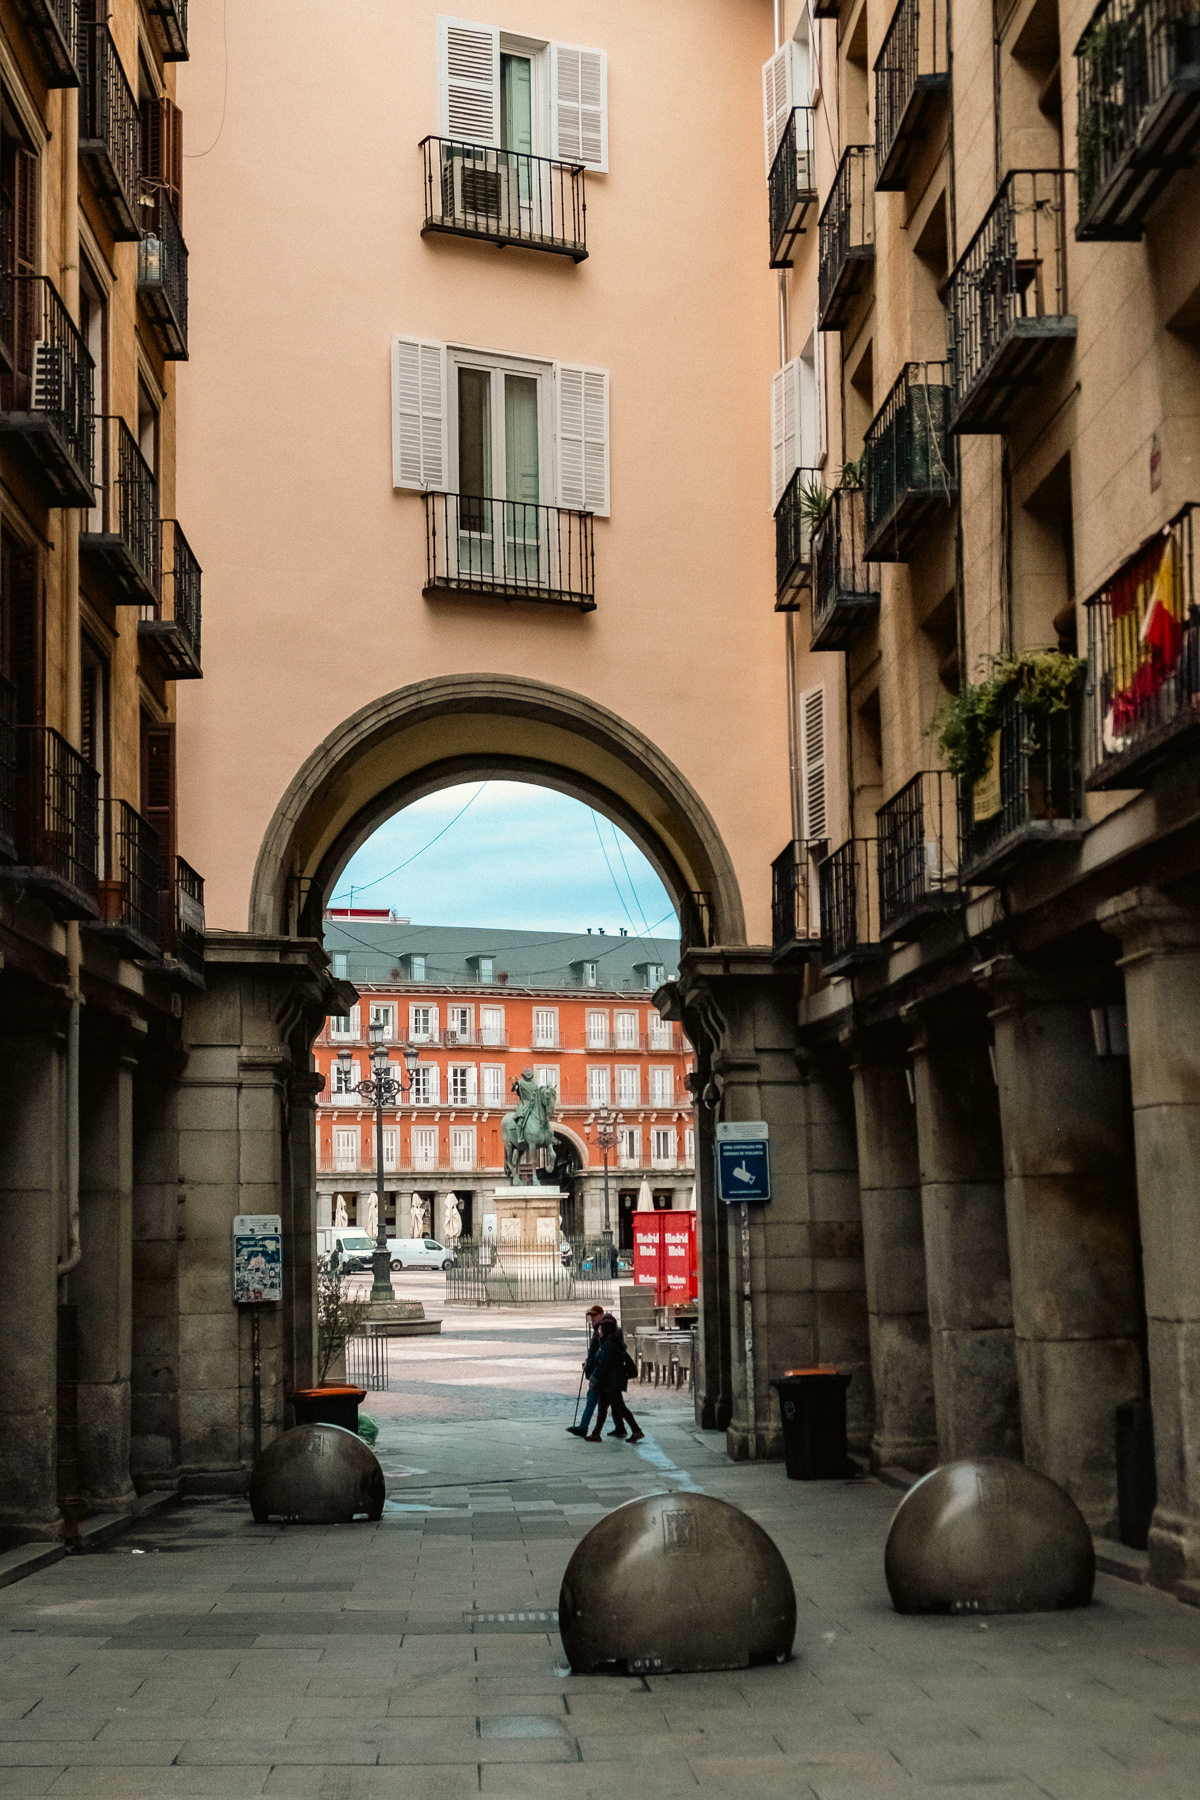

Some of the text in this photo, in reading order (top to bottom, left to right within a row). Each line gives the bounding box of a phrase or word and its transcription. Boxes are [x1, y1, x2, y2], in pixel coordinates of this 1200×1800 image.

[637, 1232, 660, 1244] Madrid
[665, 1232, 689, 1244] Madrid
[640, 1245, 657, 1256] Mola
[668, 1245, 685, 1257] Mola
[639, 1274, 657, 1284] Mahou
[667, 1275, 686, 1285] Mahou
